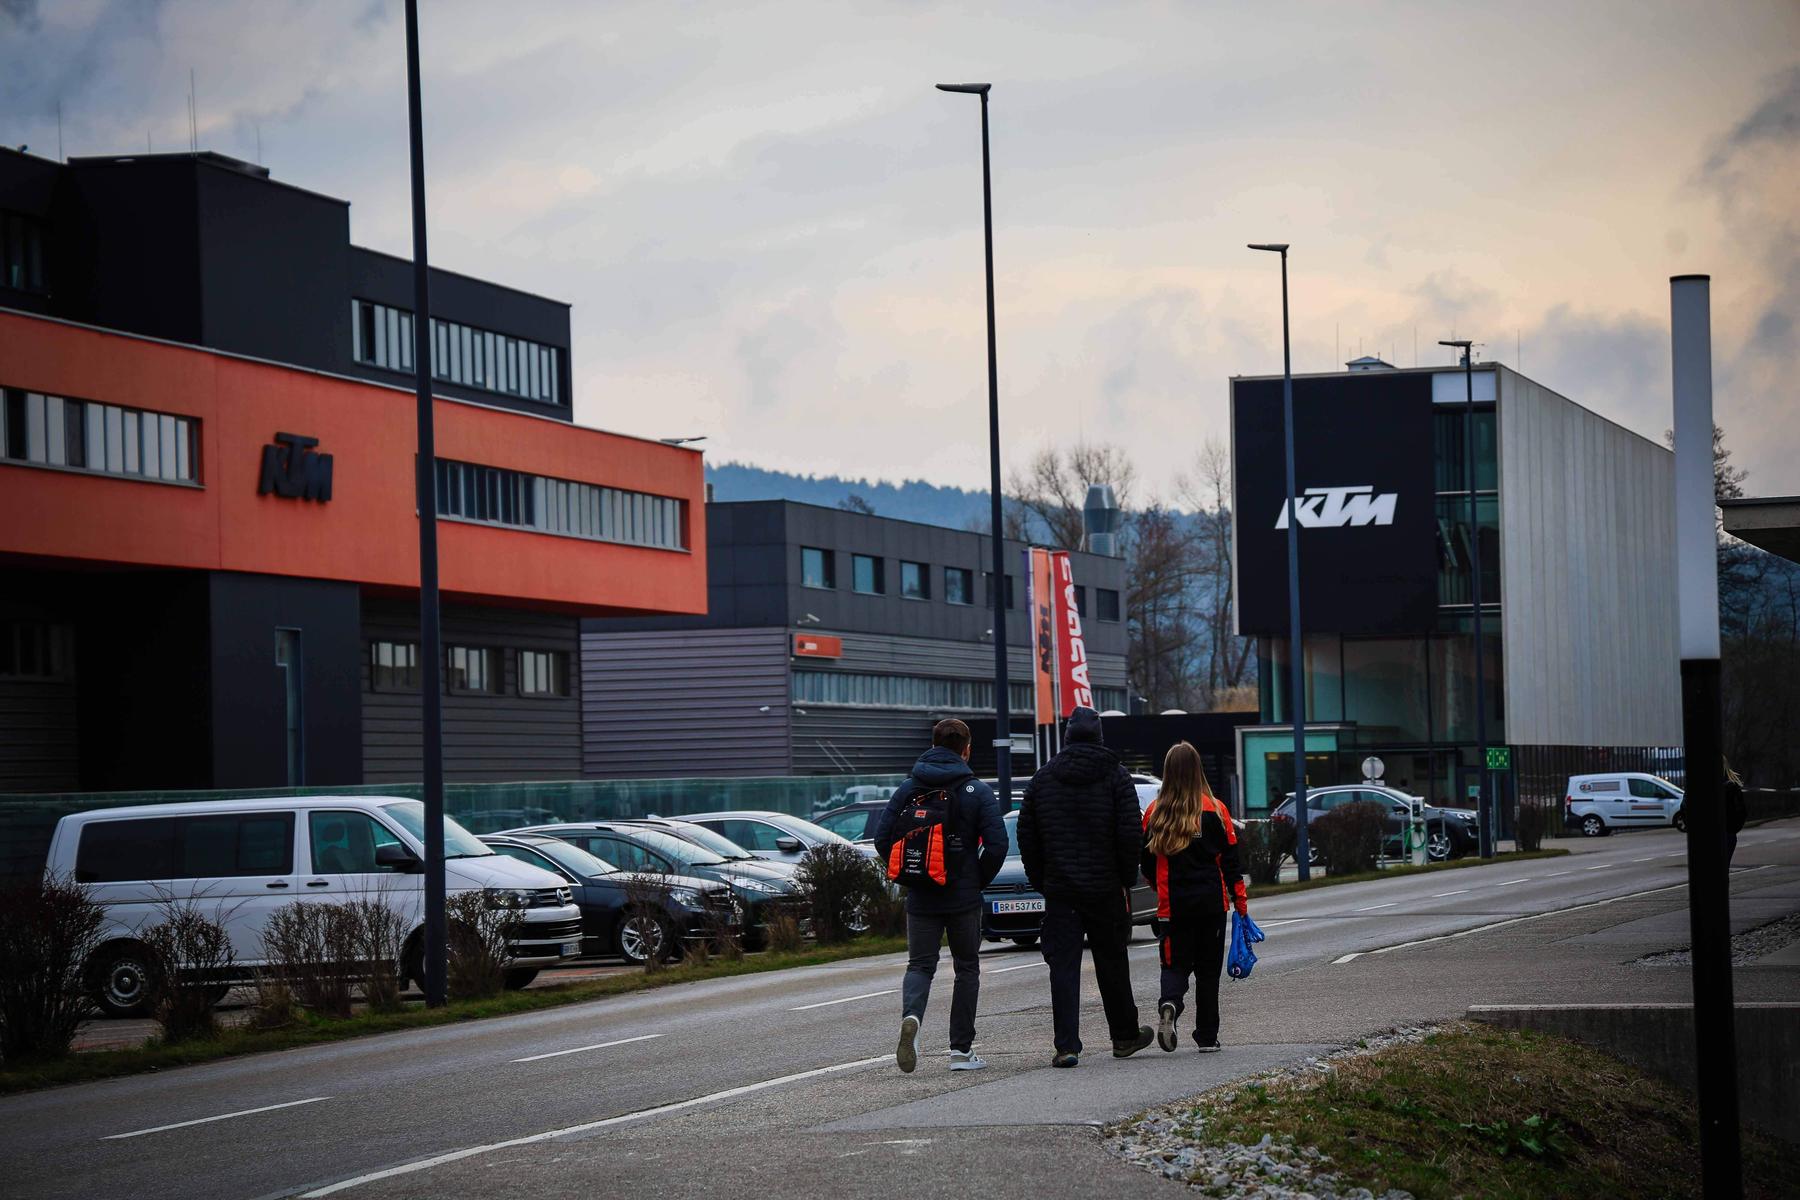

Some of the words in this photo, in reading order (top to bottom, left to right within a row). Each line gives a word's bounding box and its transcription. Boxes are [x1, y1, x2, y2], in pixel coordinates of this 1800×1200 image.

[257, 432, 333, 503] KTM
[1275, 485, 1398, 529] KTM
[1060, 556, 1095, 709] GASGAS
[1000, 903, 1010, 912] BR
[1015, 902, 1031, 911] 537
